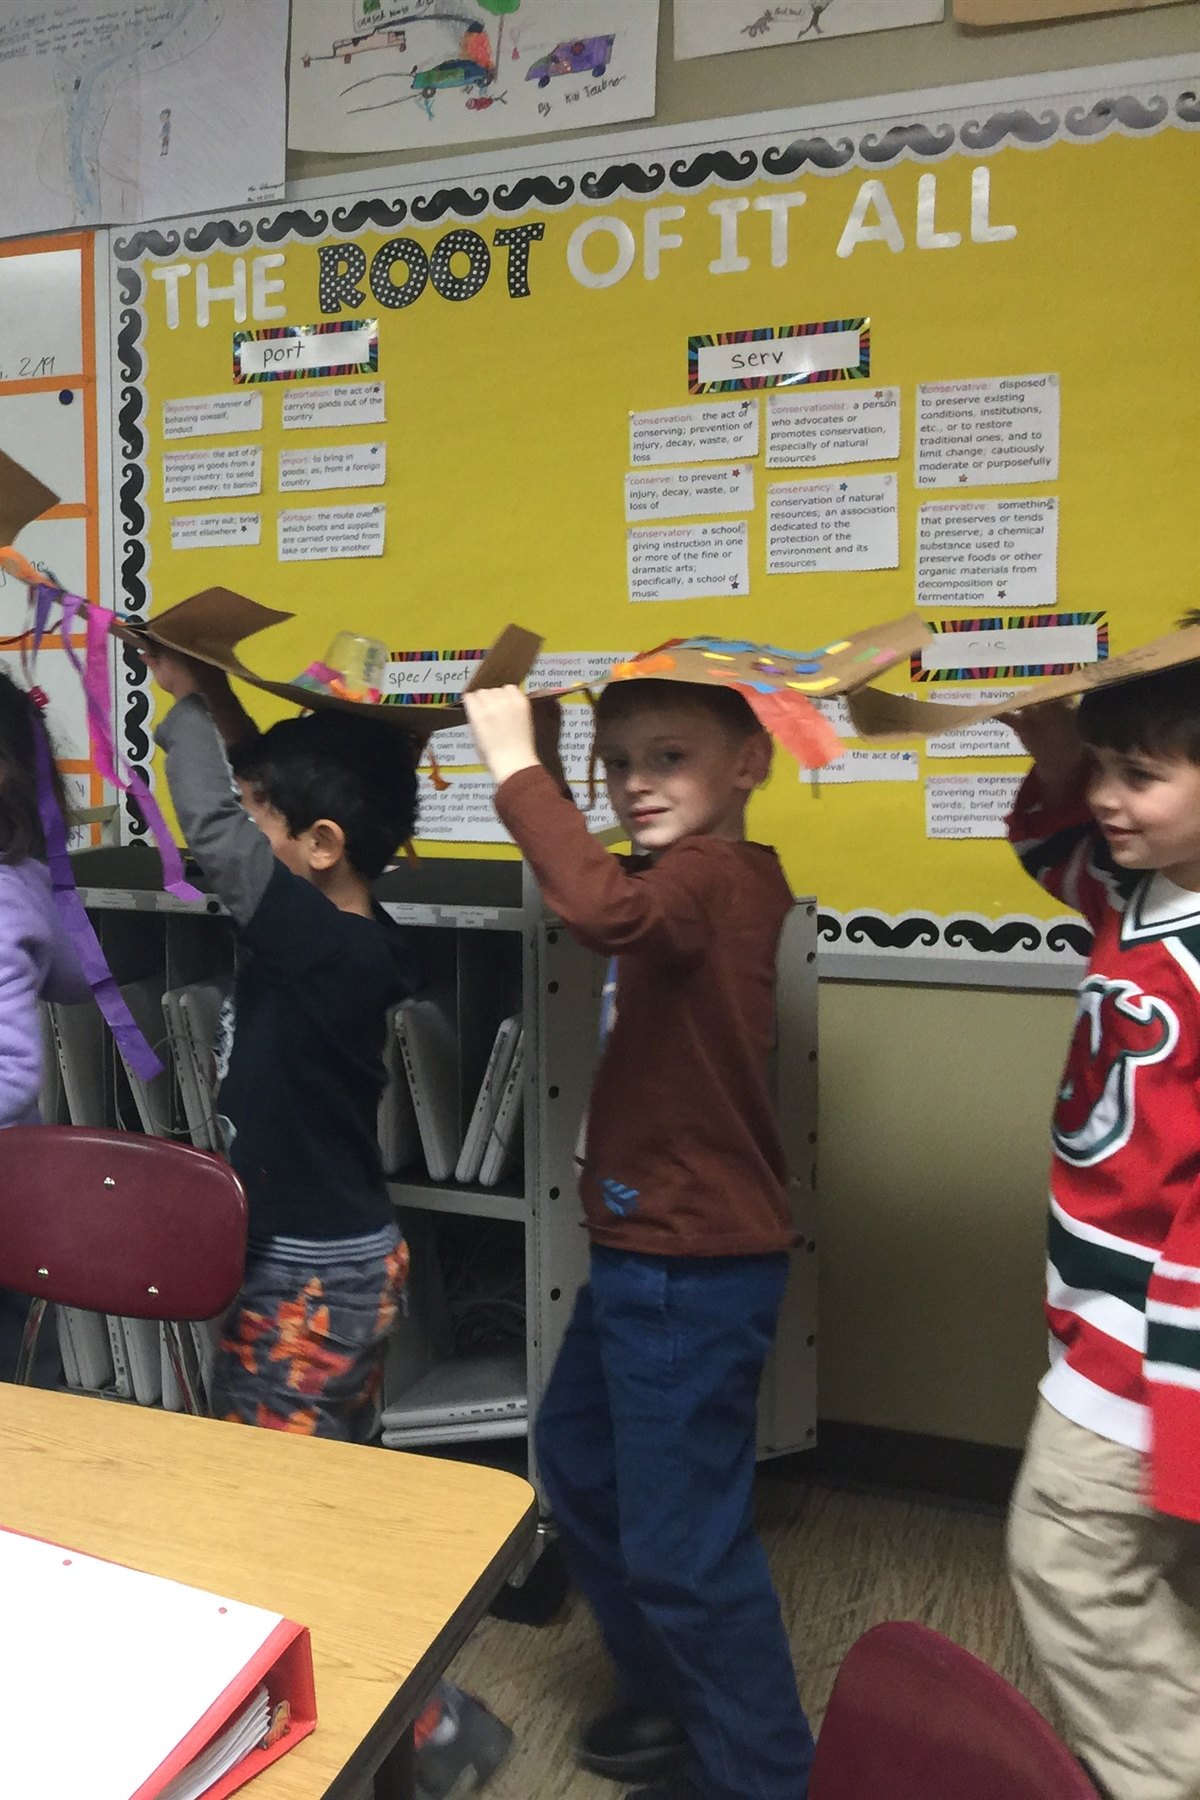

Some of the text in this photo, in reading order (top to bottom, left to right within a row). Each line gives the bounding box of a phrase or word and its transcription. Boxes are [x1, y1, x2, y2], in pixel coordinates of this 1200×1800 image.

[152, 166, 1018, 330] THE ROOT OF IT ALL
[263, 341, 306, 368] port
[731, 349, 784, 370] serv
[862, 400, 896, 410] person
[921, 392, 1025, 407] to preserve existing
[702, 410, 718, 420] the
[720, 410, 736, 419] act
[738, 408, 748, 417] of
[771, 416, 791, 426] who
[793, 414, 844, 425] advocates
[690, 421, 740, 435] prevention
[743, 420, 753, 429] of
[770, 428, 817, 440] promotes
[769, 437, 868, 452] especially of natural
[632, 452, 651, 461] loss
[769, 454, 816, 463] resources
[919, 456, 1051, 470] moderate or purposefully
[678, 473, 688, 482] to
[690, 471, 727, 483] prevent
[918, 474, 936, 483] low
[920, 515, 941, 524] that
[944, 515, 996, 525] preserves
[1013, 512, 1043, 521] tends
[632, 541, 660, 552] giving
[662, 538, 711, 548] instruction
[714, 537, 723, 546] in
[918, 564, 1037, 577] organic materials from
[918, 578, 993, 589] decomposition
[917, 591, 984, 600] fermentation
[528, 678, 562, 689] prudent
[930, 740, 1010, 750] most important
